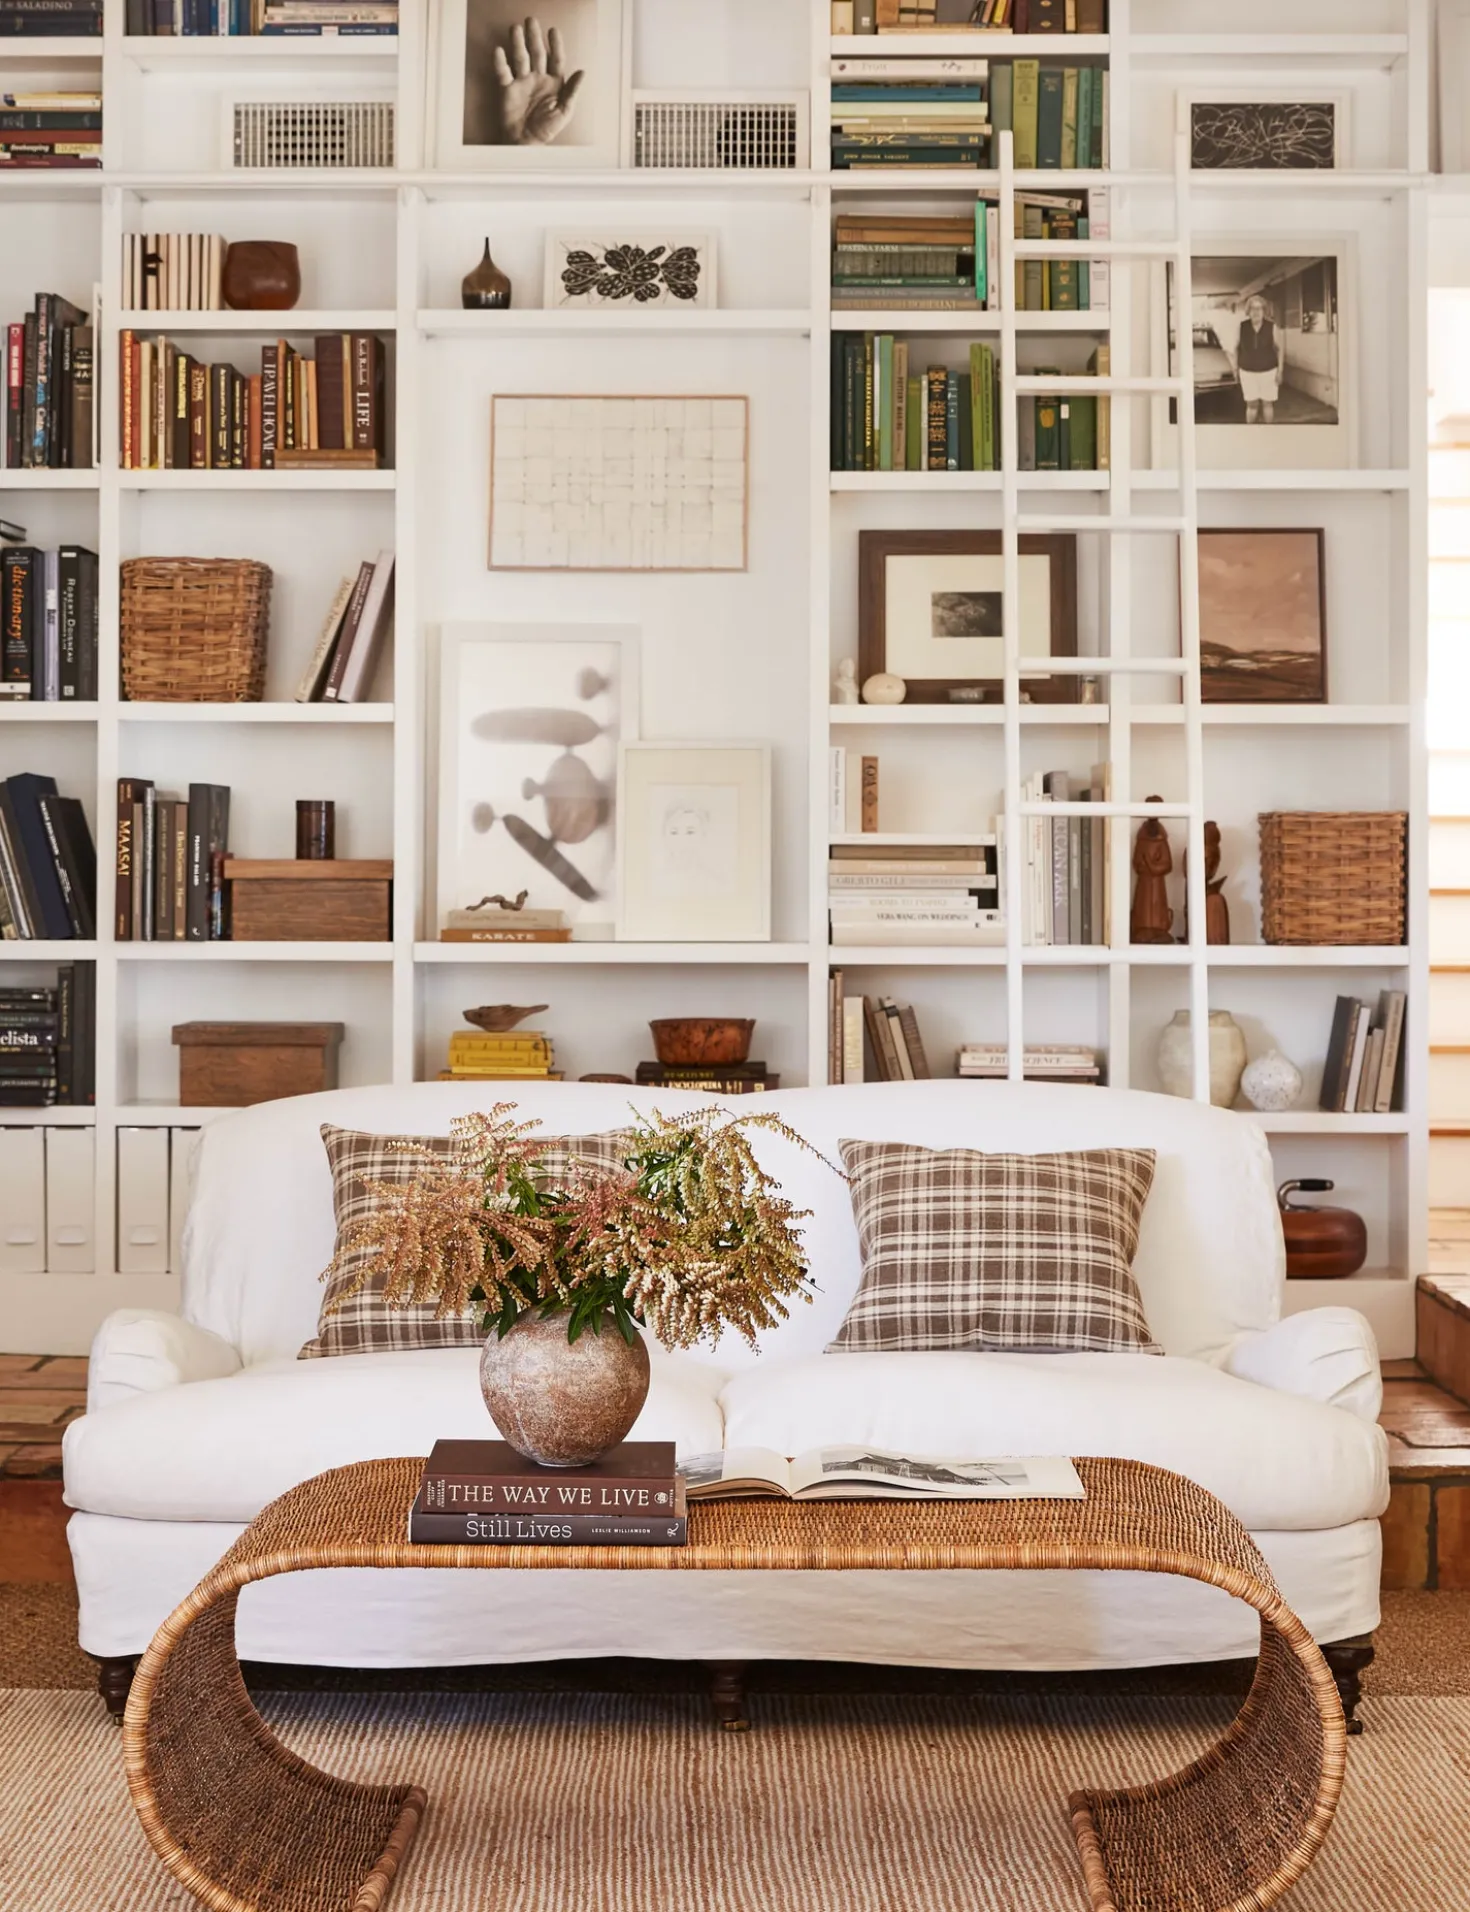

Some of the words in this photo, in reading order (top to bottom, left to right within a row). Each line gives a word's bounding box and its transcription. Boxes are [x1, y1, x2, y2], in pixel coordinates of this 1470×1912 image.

[263, 363, 277, 407] TRAVEL
[356, 392, 370, 428] LIFE
[262, 411, 277, 453] HOME
[67, 578, 77, 616] ROBERT
[66, 619, 77, 663] DOISNEAU
[118, 820, 131, 877] MAASAI
[472, 932, 536, 941] KARATE
[448, 1484, 494, 1502] THE
[501, 1486, 551, 1504] WAY
[557, 1487, 593, 1505] WE
[600, 1488, 650, 1507] LIVE
[466, 1520, 512, 1538] Still
[516, 1520, 573, 1539] Lives
